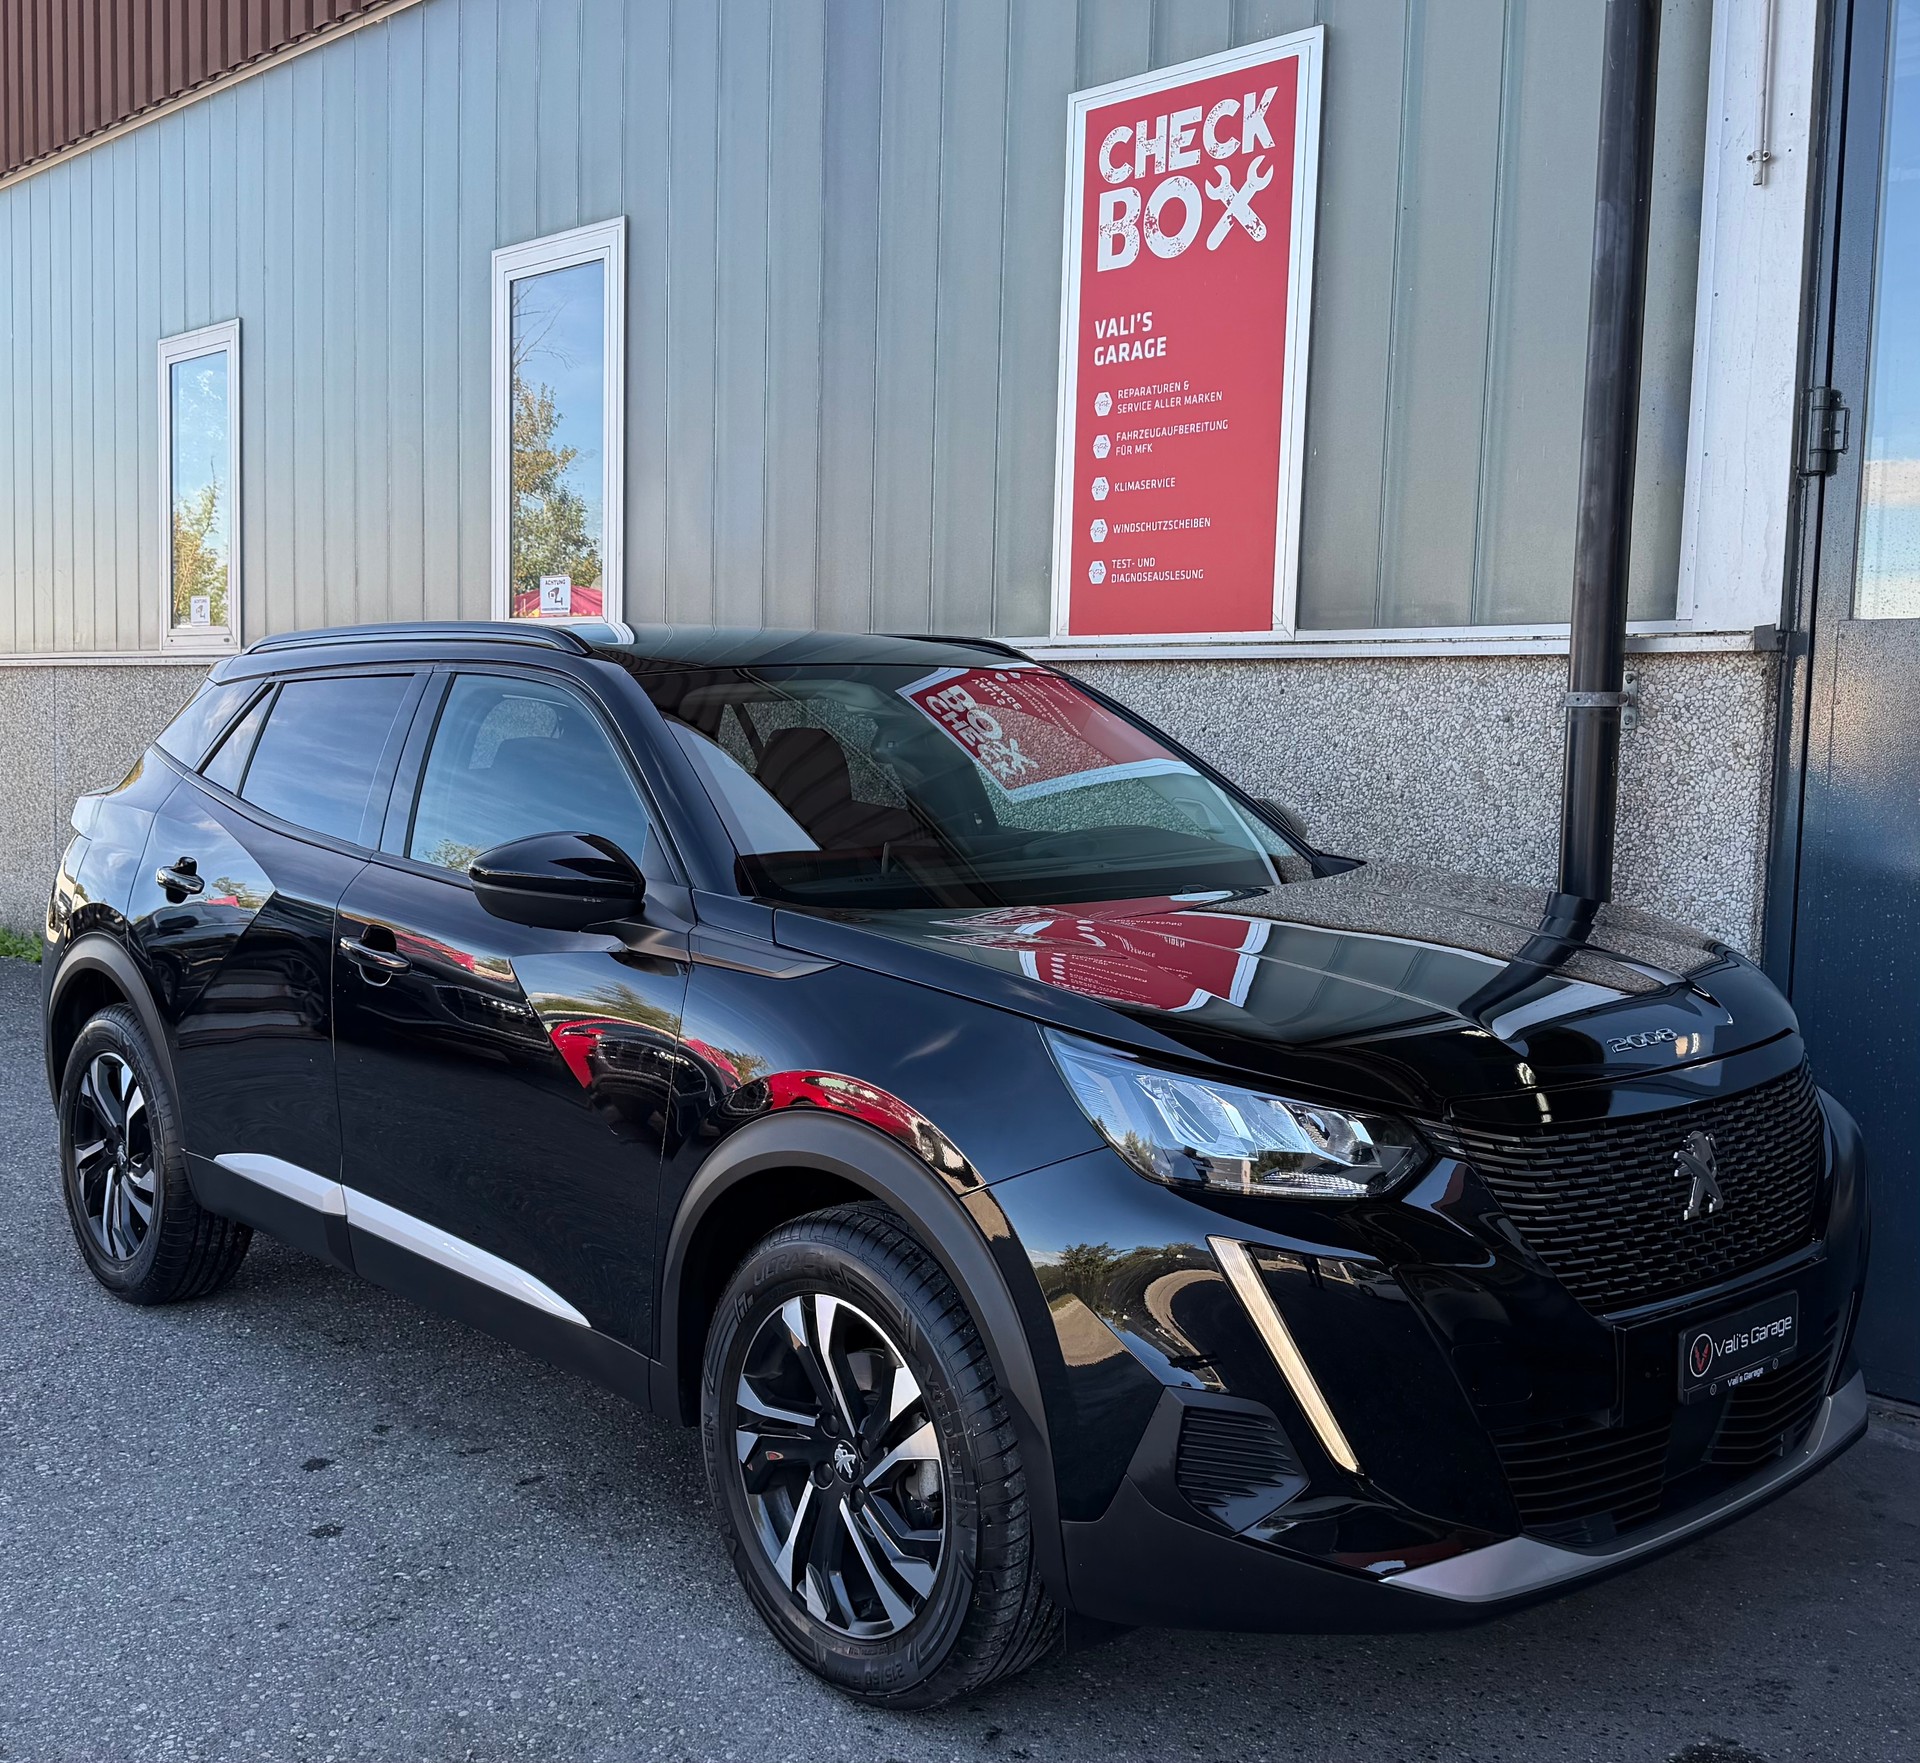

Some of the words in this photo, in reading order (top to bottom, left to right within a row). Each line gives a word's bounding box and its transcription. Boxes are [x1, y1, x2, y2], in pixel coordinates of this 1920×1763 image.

[1098, 85, 1279, 184] CHECK
[1094, 312, 1153, 340] VALI'S
[1093, 336, 1167, 367] GARAGE
[1117, 382, 1181, 400] REPARATUREN
[1117, 400, 1152, 414] SERVICE
[1154, 397, 1182, 410] ALLER
[1184, 391, 1223, 406] MARKEN
[1116, 419, 1229, 442] FAHRZEUGAUFBEREITUNG
[1134, 443, 1153, 454] MFK
[1114, 477, 1176, 492] KLIMASERVICE
[1112, 517, 1211, 534] WINDSCHUTZSCHEIBEN
[1111, 559, 1135, 569] TEST-
[1137, 557, 1156, 568] UND
[1111, 569, 1204, 584] DIAGNOSEAUSLESUNG
[1606, 1027, 1678, 1054] 2008
[1714, 1333, 1749, 1357] Vali's
[1750, 1316, 1793, 1344] Garage
[1727, 1373, 1744, 1387] Vali's
[1743, 1367, 1765, 1381] Garage
